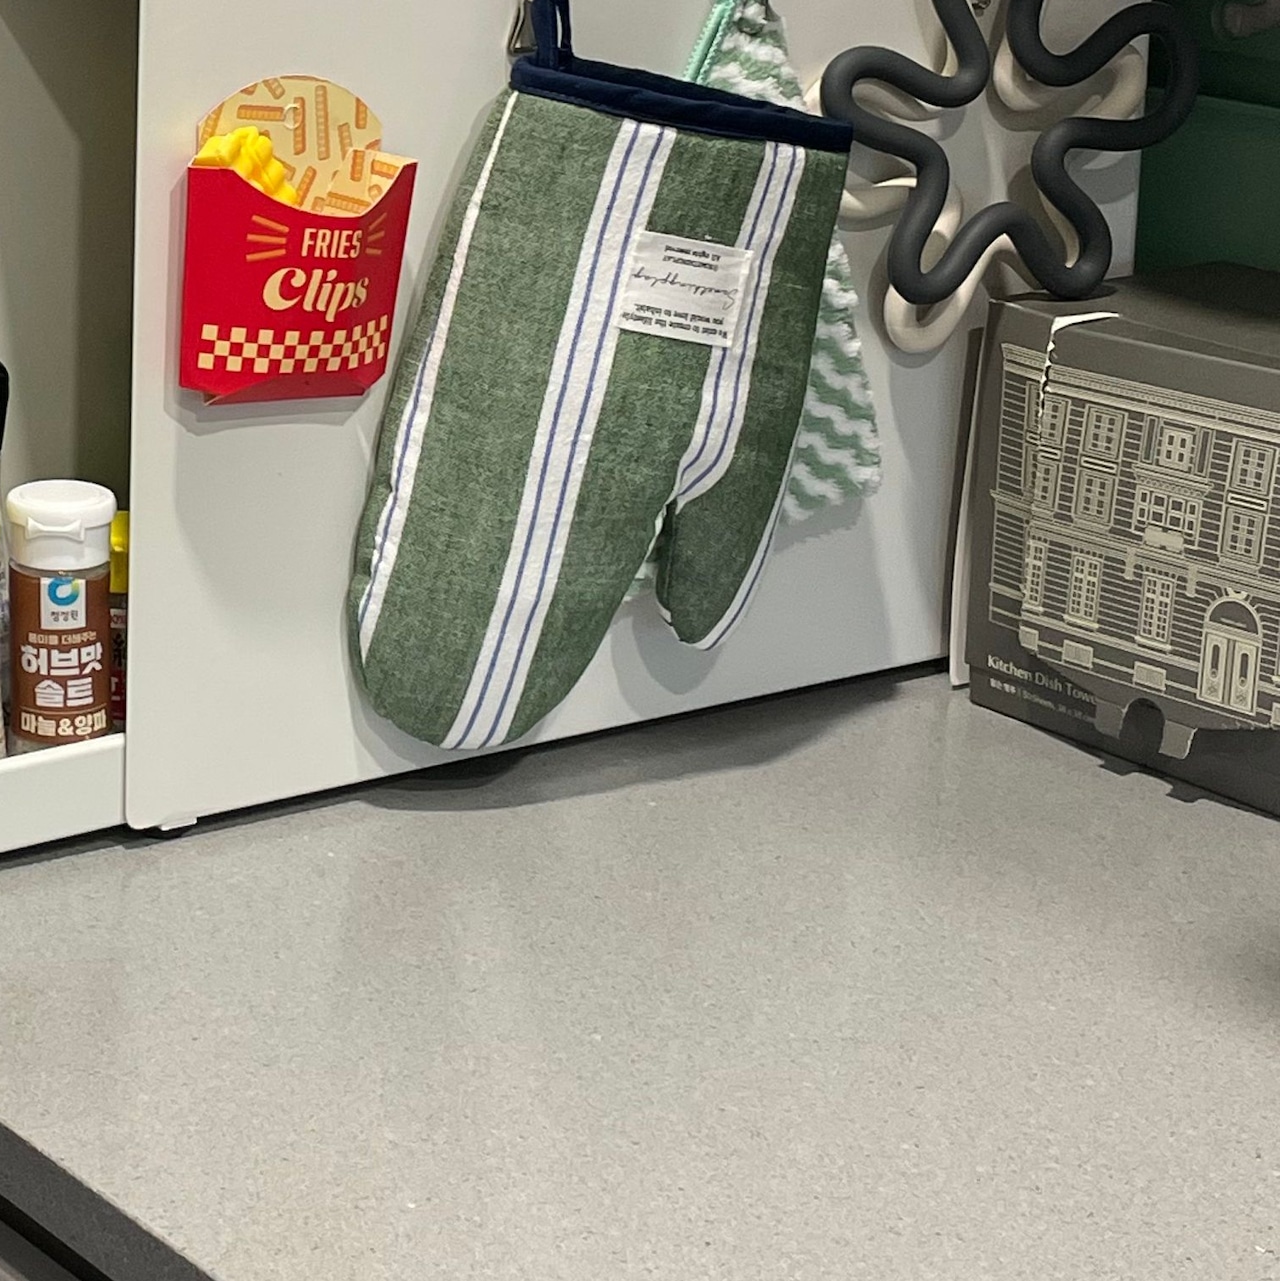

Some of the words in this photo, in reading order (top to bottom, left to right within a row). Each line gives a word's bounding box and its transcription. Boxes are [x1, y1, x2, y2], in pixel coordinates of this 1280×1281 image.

[301, 227, 363, 259] FRIES
[262, 267, 369, 322] Clips
[51, 609, 79, 622] 청정원
[20, 641, 104, 676] 허브맛
[987, 654, 1033, 681] Kitchen
[1035, 672, 1063, 692] Dish
[34, 676, 95, 708] 솔트
[21, 708, 107, 737] 마늘&양파
